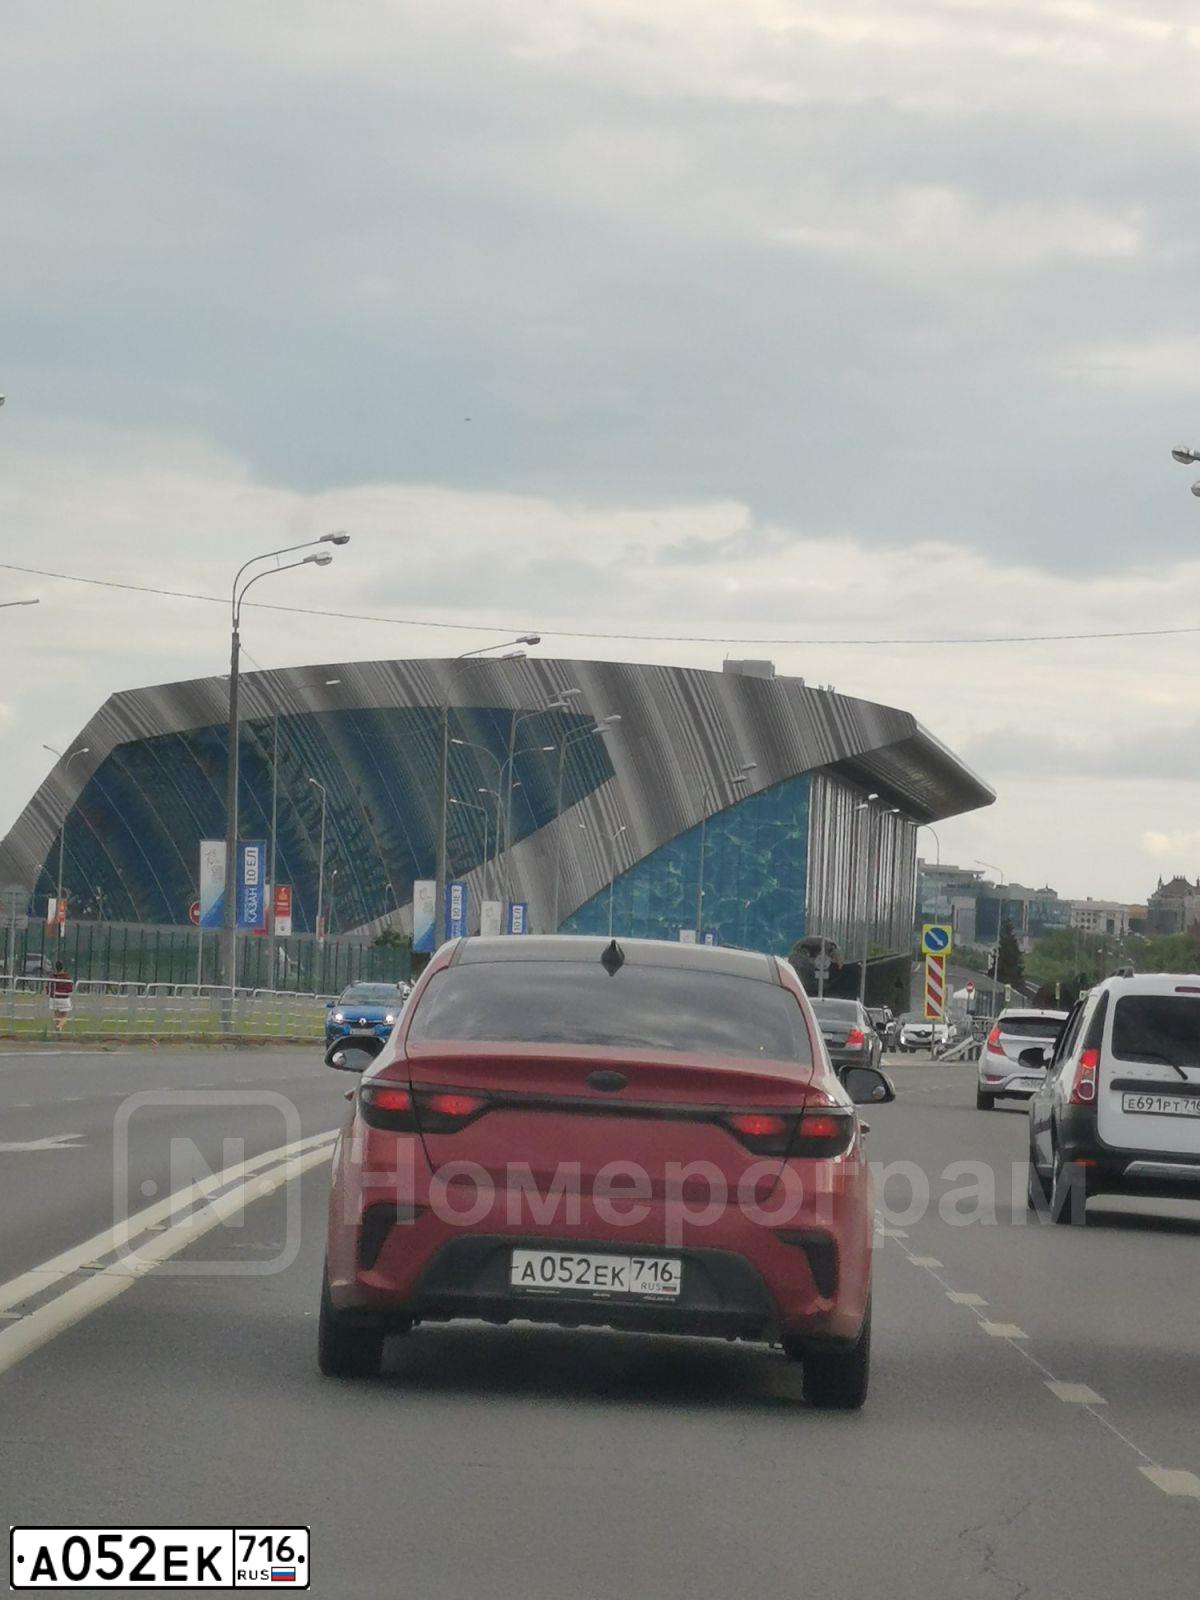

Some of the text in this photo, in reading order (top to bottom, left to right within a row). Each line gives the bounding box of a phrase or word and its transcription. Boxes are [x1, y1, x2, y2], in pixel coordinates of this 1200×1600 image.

[521, 1256, 673, 1287] А052ЕК 716
[640, 1282, 662, 1292] RUS
